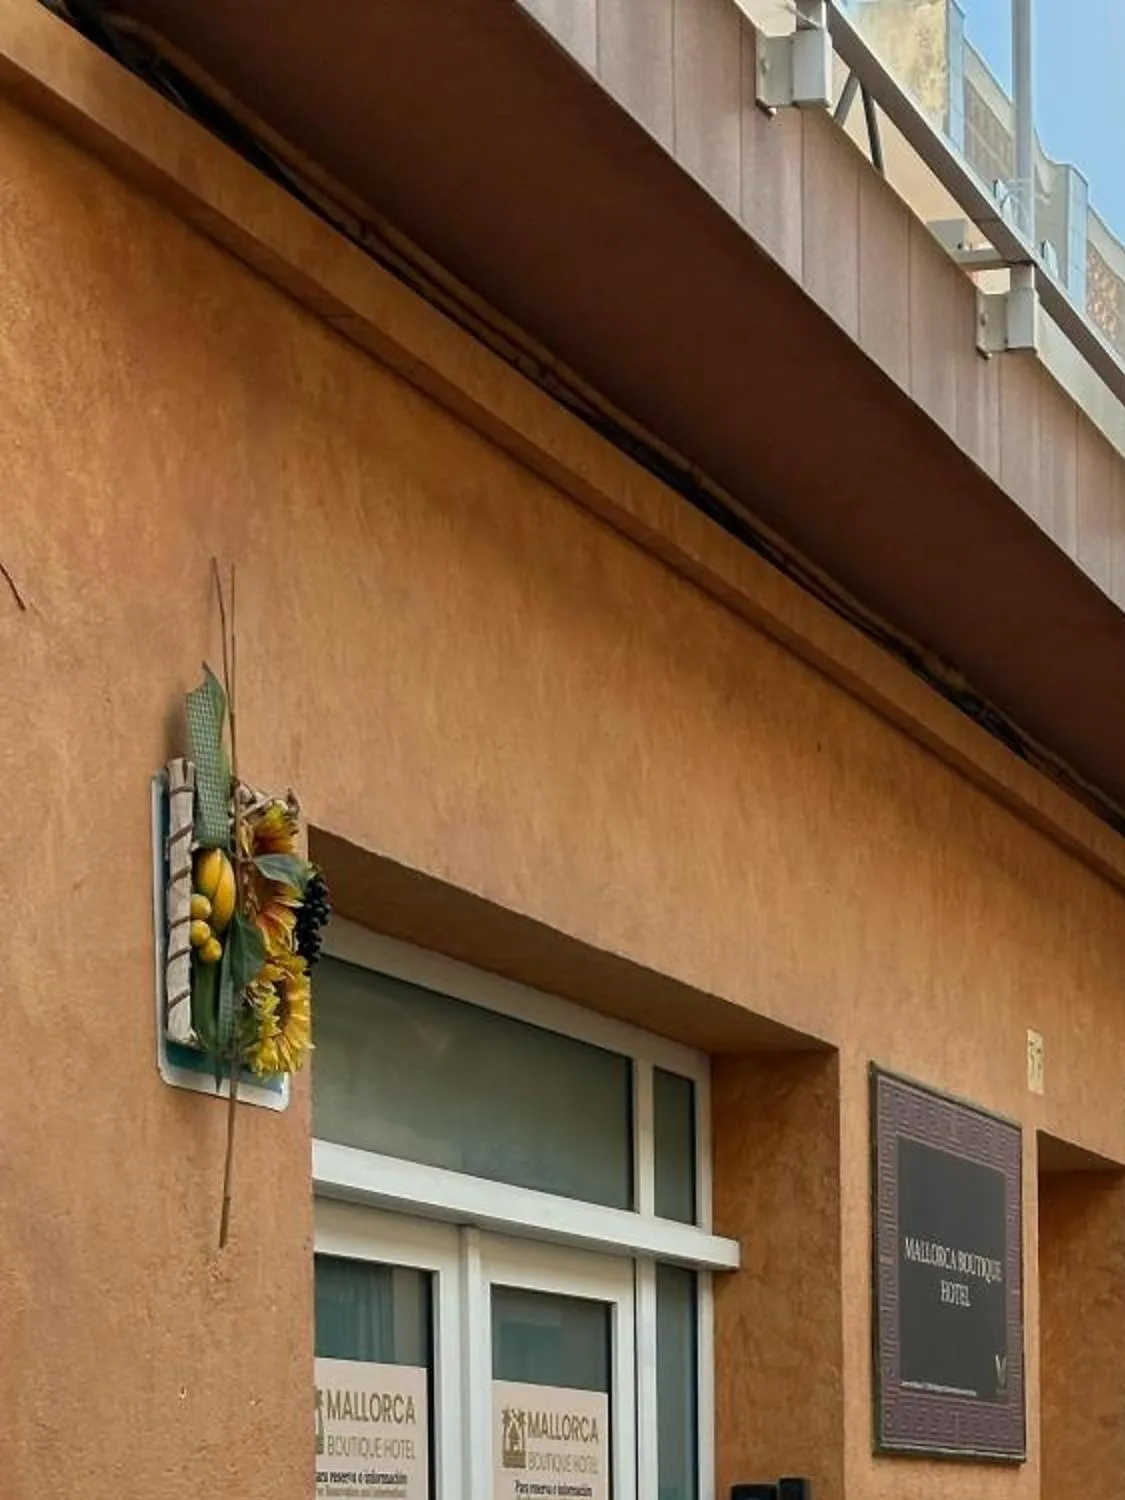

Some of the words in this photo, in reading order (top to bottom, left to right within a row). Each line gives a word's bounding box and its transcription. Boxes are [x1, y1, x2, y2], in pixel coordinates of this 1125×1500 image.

[904, 1237, 957, 1271] MALLORCA
[959, 1251, 1001, 1284] BOUTIQUE
[941, 1280, 971, 1307] HOTEL
[327, 1388, 416, 1425] MALLORCA
[527, 1411, 599, 1444] MALLORCA
[327, 1434, 382, 1461] BOUTIQUE
[384, 1437, 416, 1461] HOTEL
